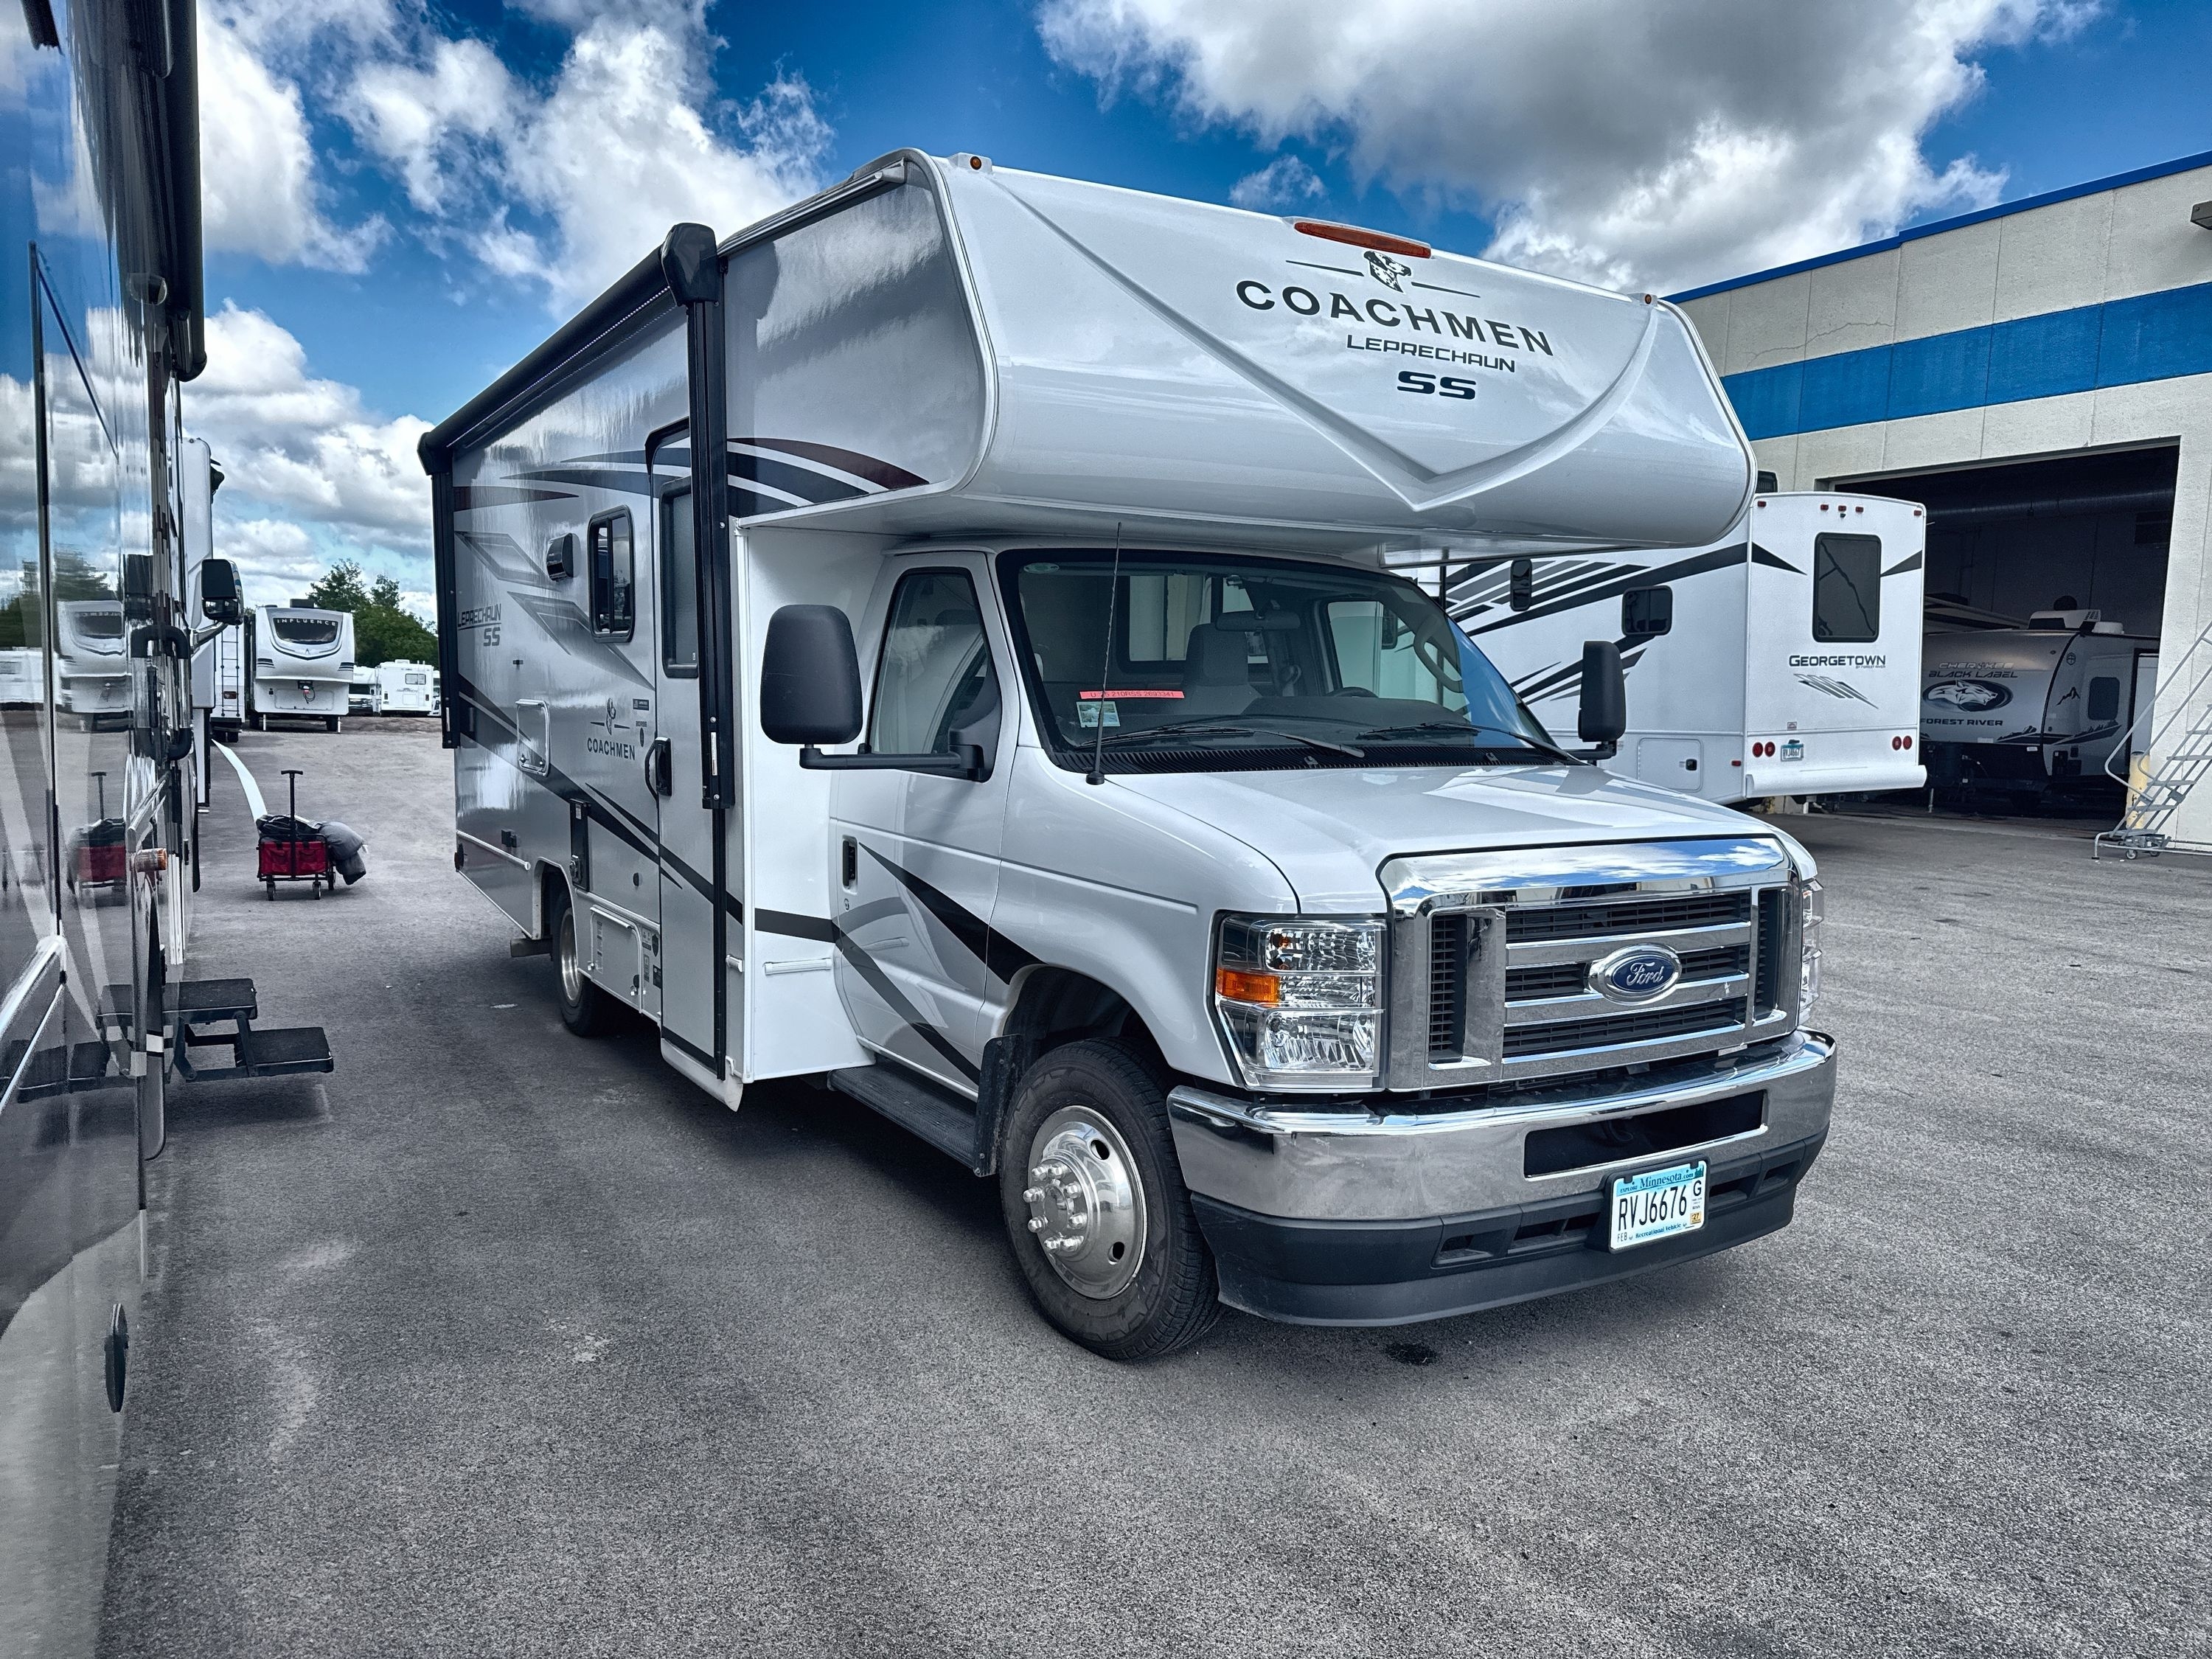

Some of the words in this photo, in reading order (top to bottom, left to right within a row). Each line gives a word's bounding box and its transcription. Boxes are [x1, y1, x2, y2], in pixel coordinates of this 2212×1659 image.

[1236, 280, 1554, 356] COACHMEN
[1346, 334, 1516, 373] LEPRECHAUN
[1397, 370, 1477, 400] SS
[276, 619, 336, 627] INFLUENCE
[457, 603, 501, 627] LEPRECHAUN
[483, 627, 501, 647] SS
[1788, 655, 1886, 667] GEORGETOWN
[587, 737, 636, 761] COACHMEN
[1626, 961, 1665, 987] Ford
[1693, 1180, 1702, 1197] G
[1618, 1184, 1687, 1231] RVJ6676
[1617, 1231, 1627, 1242] FEB
[1635, 1226, 1665, 1239] Recreational
